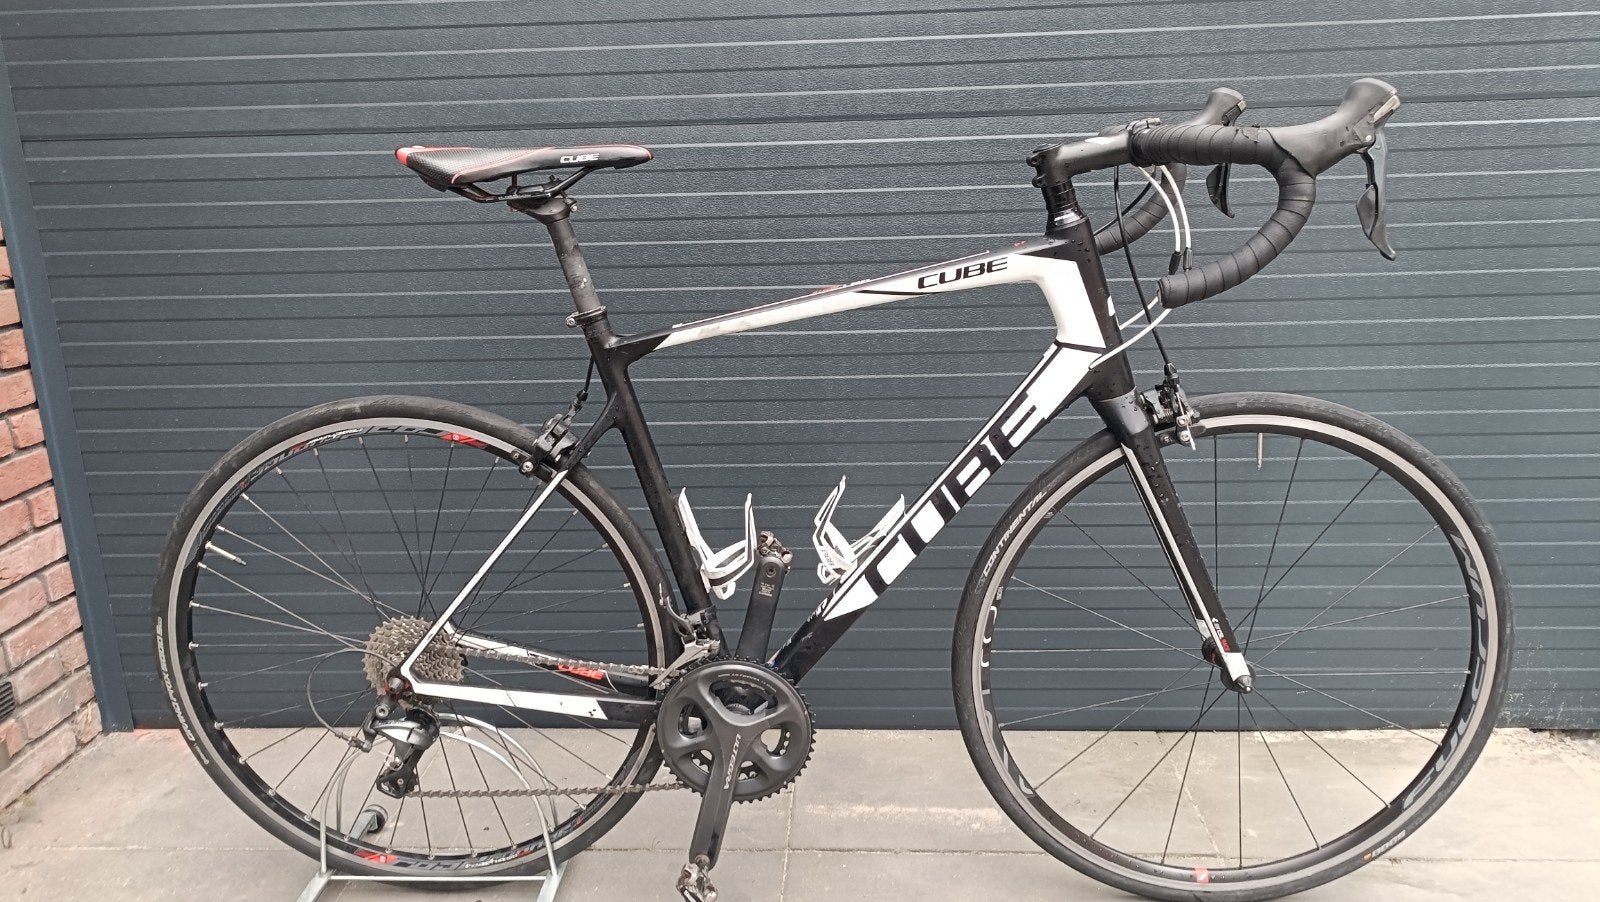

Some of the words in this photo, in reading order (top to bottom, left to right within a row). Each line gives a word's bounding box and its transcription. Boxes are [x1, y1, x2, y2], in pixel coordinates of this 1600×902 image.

[560, 153, 600, 164] CUBE
[918, 256, 1008, 290] CUBE
[983, 490, 1048, 577] CONTINENTAL
[1403, 533, 1488, 810] FULCRUM
[723, 733, 741, 790] ULTEGRA
